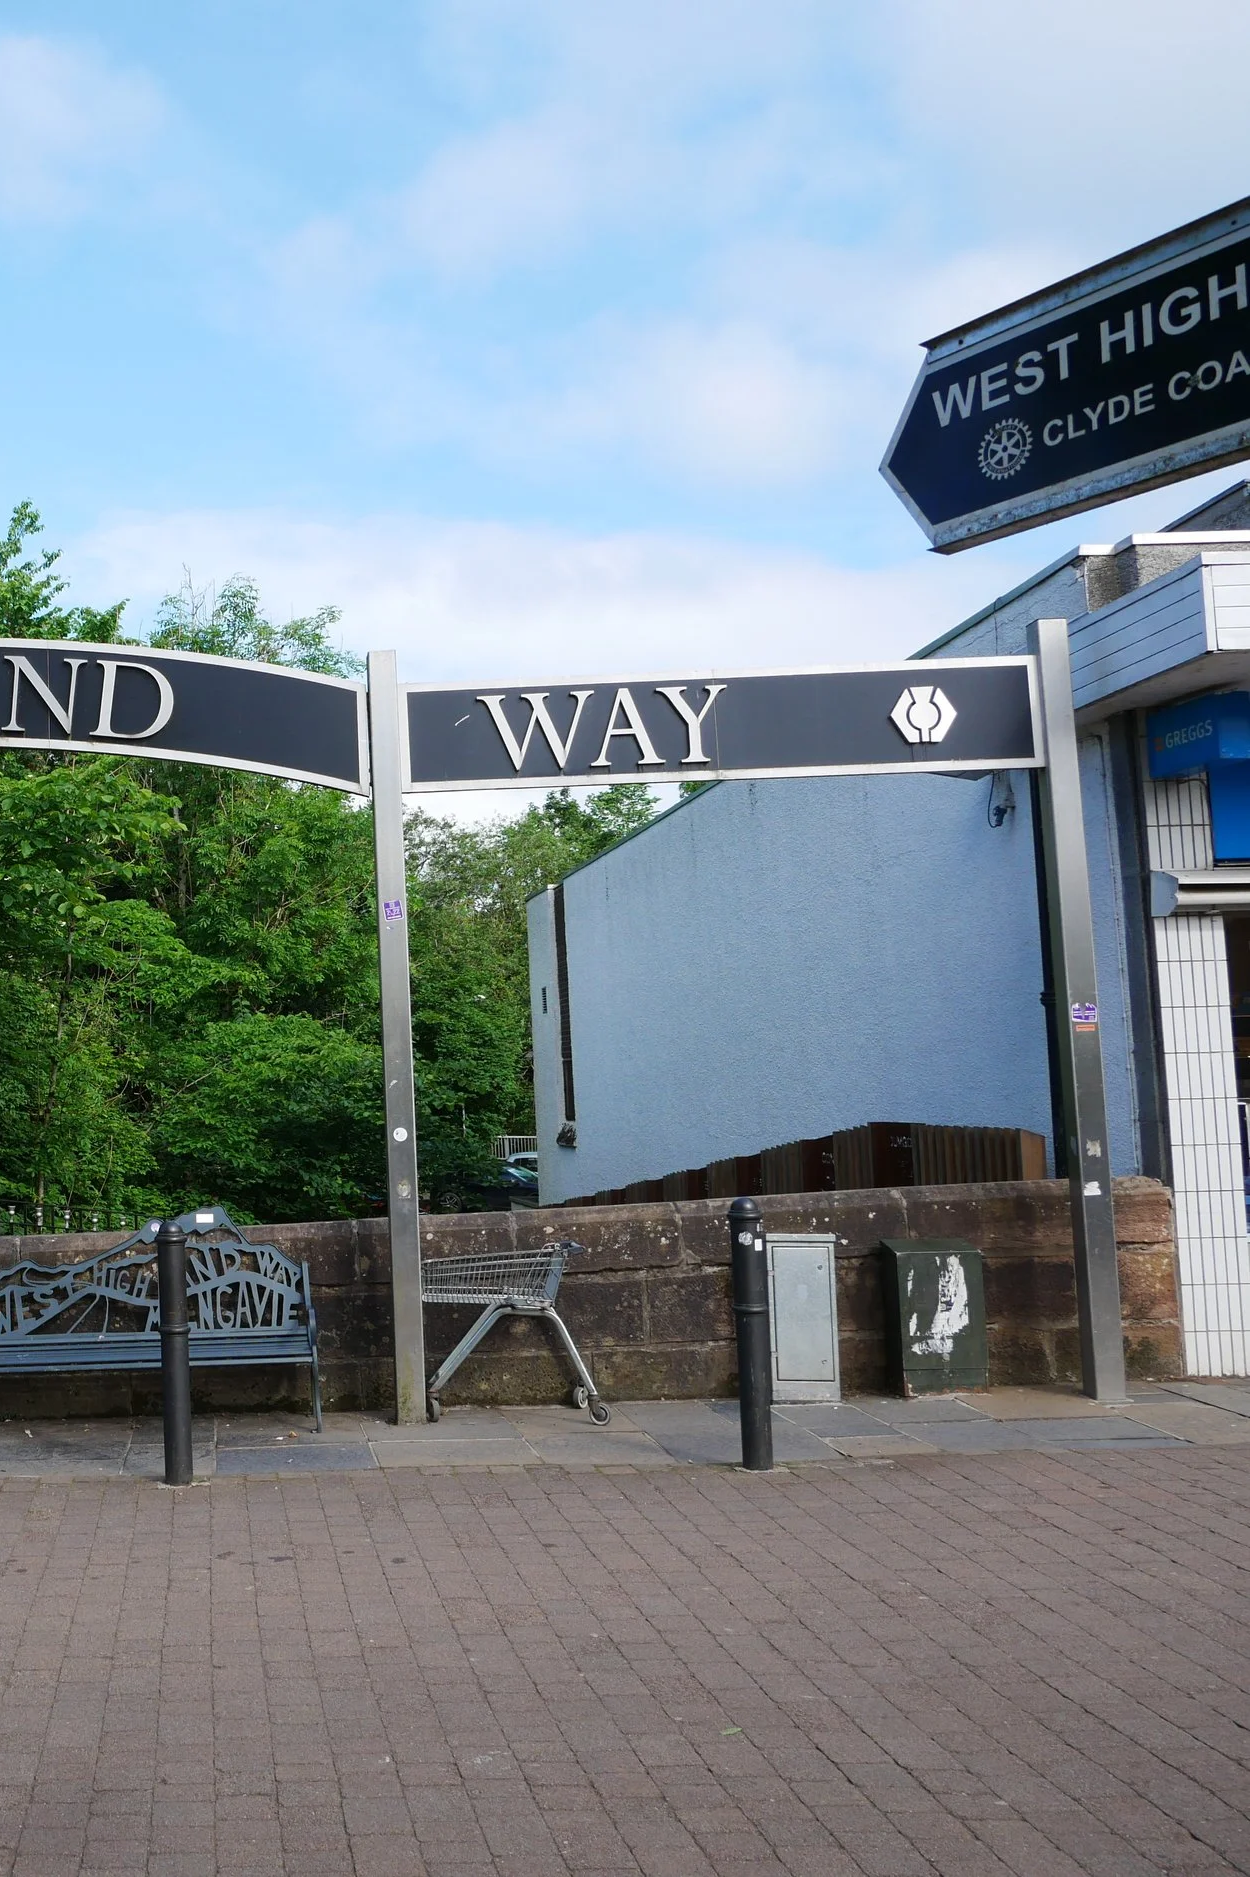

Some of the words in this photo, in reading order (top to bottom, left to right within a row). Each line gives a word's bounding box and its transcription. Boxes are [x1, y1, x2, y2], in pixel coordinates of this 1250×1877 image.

[932, 333, 1079, 428] WEST
[1100, 263, 1249, 365] HIGH
[1042, 384, 1155, 446] CLYDE
[475, 684, 728, 772] WAY
[1165, 719, 1214, 749] GREGGS
[255, 1250, 301, 1292] WAY
